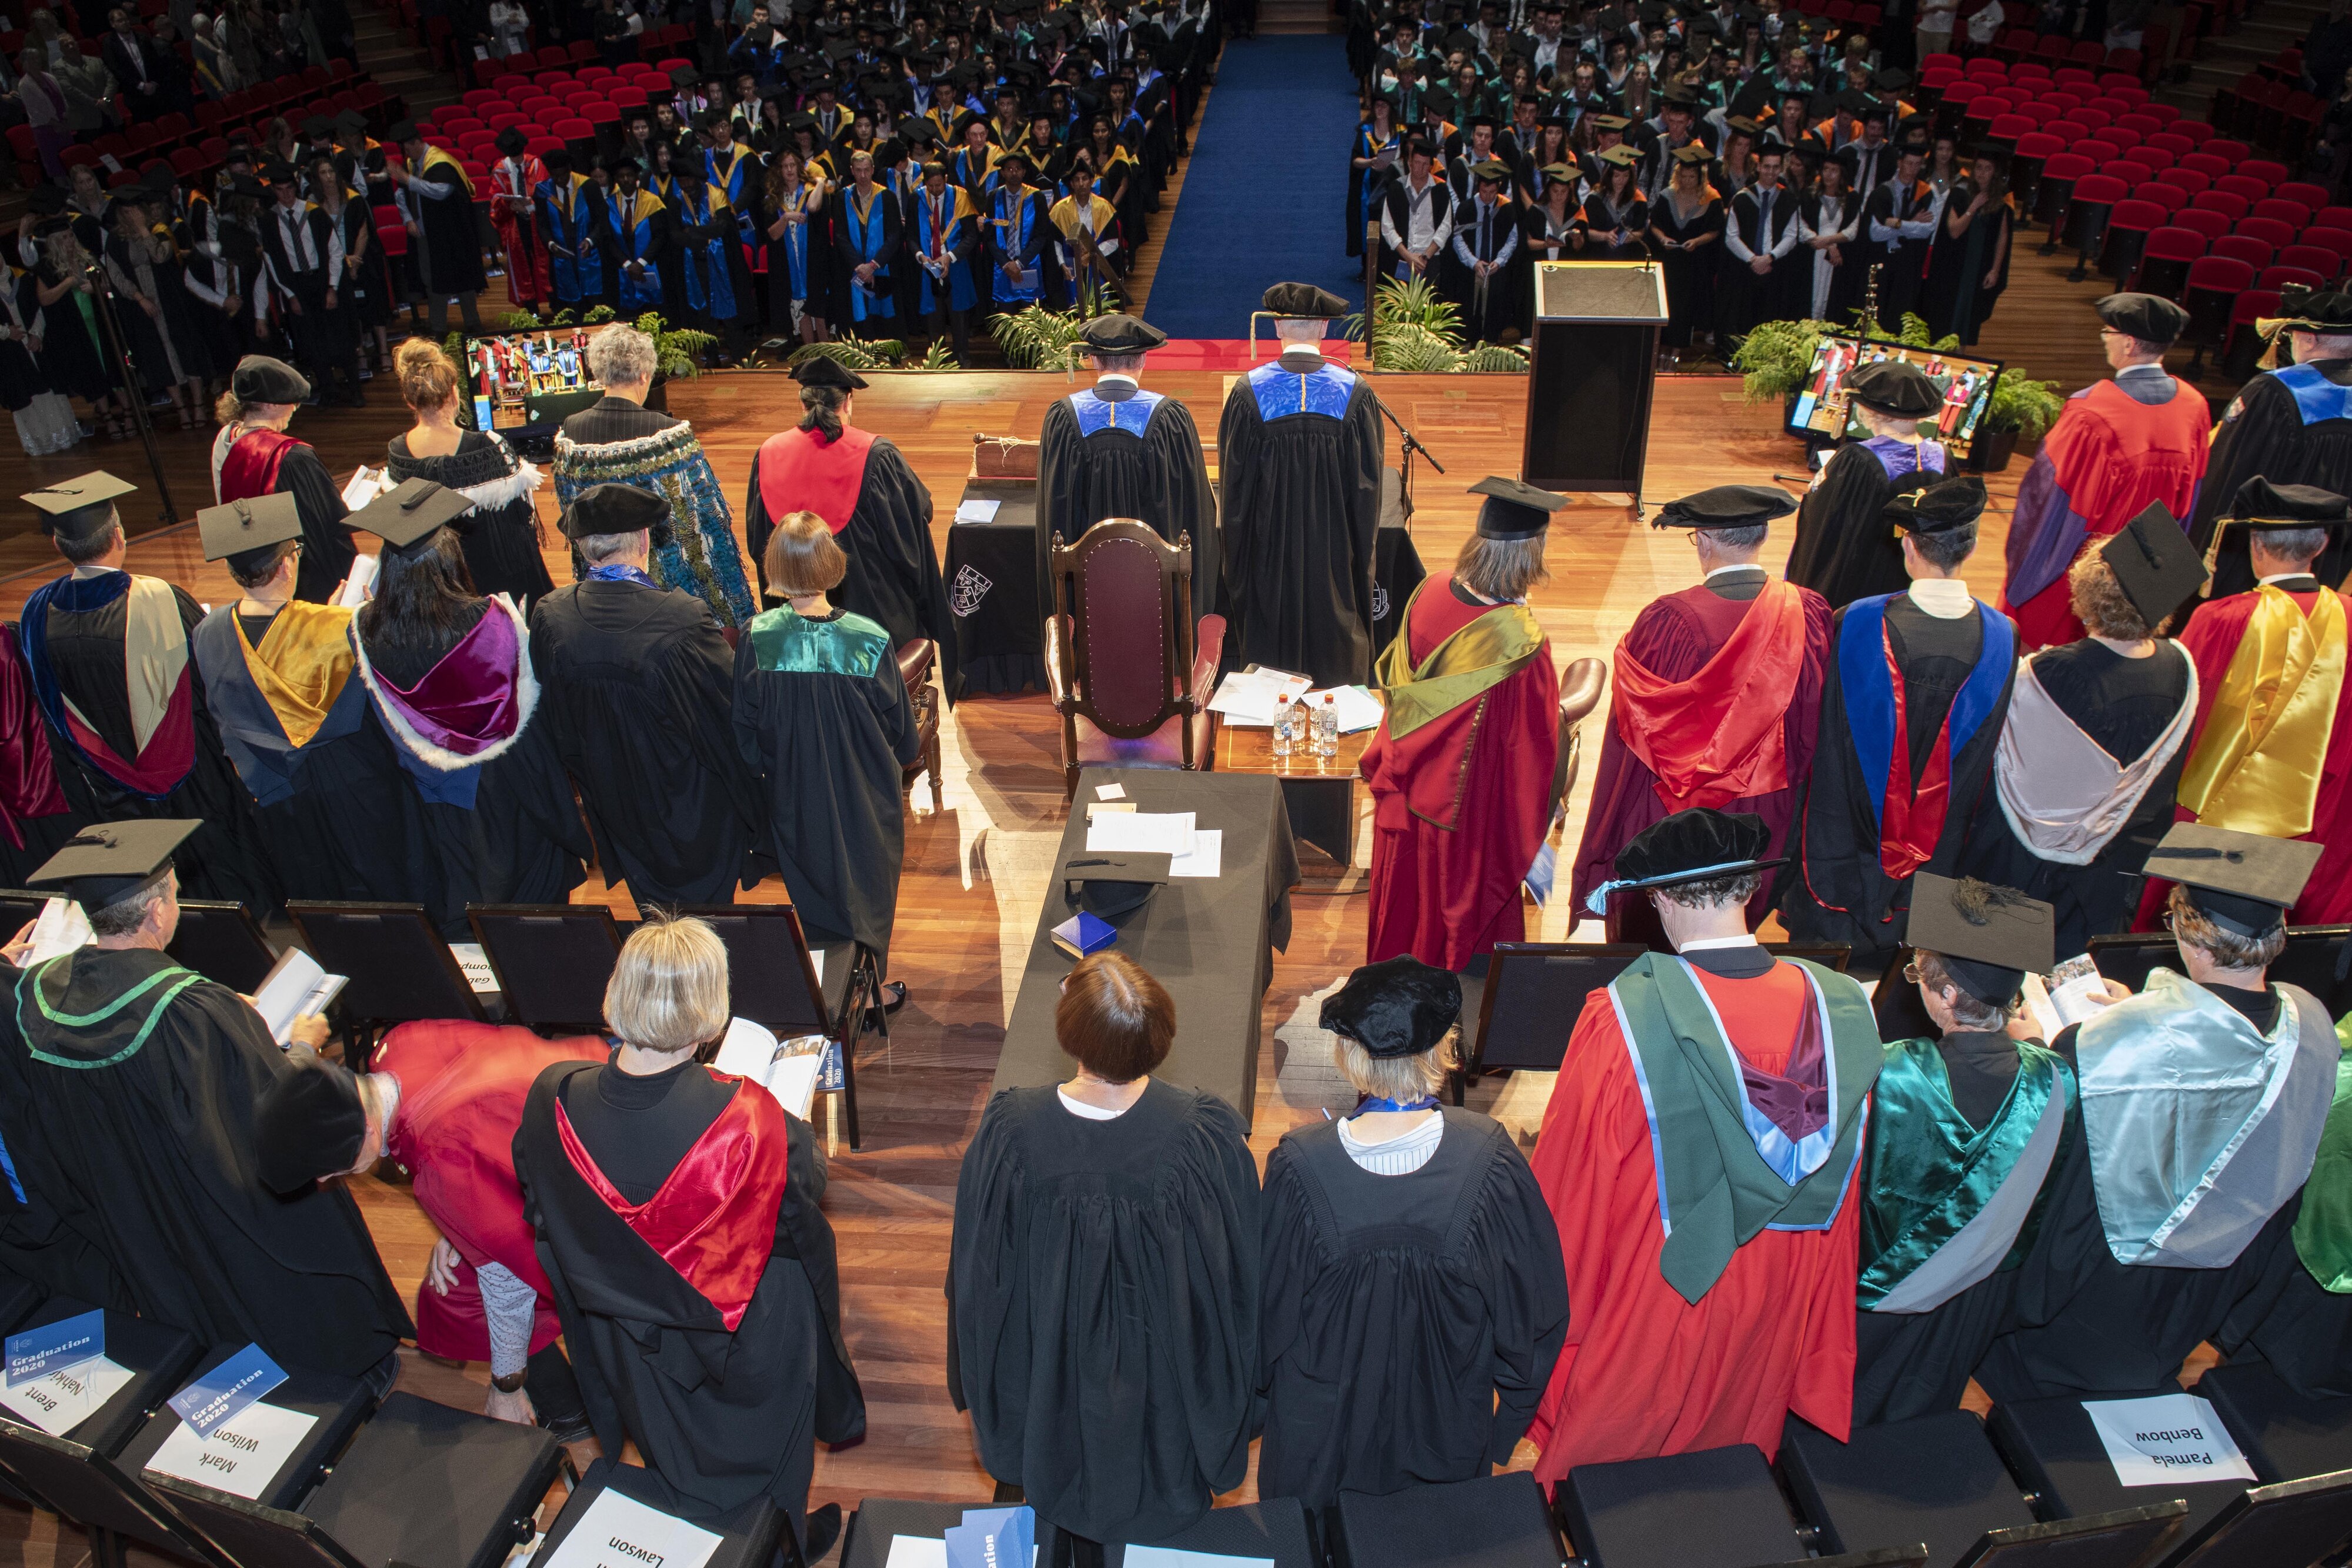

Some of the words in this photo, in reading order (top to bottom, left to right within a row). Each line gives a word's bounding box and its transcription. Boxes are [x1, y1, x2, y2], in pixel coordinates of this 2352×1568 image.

[825, 1049, 834, 1086] Graduation
[12, 1336, 91, 1367] Graduation
[12, 1360, 46, 1376] 2020
[25, 1386, 58, 1412] Brent
[192, 1369, 263, 1421] Graduation
[197, 1403, 229, 1428] 2020
[213, 1429, 259, 1452] Wilson
[2136, 1428, 2204, 1443] Benbow
[199, 1452, 238, 1473] Mark
[2151, 1452, 2214, 1467] Pamela
[609, 1536, 665, 1568] Lawson
